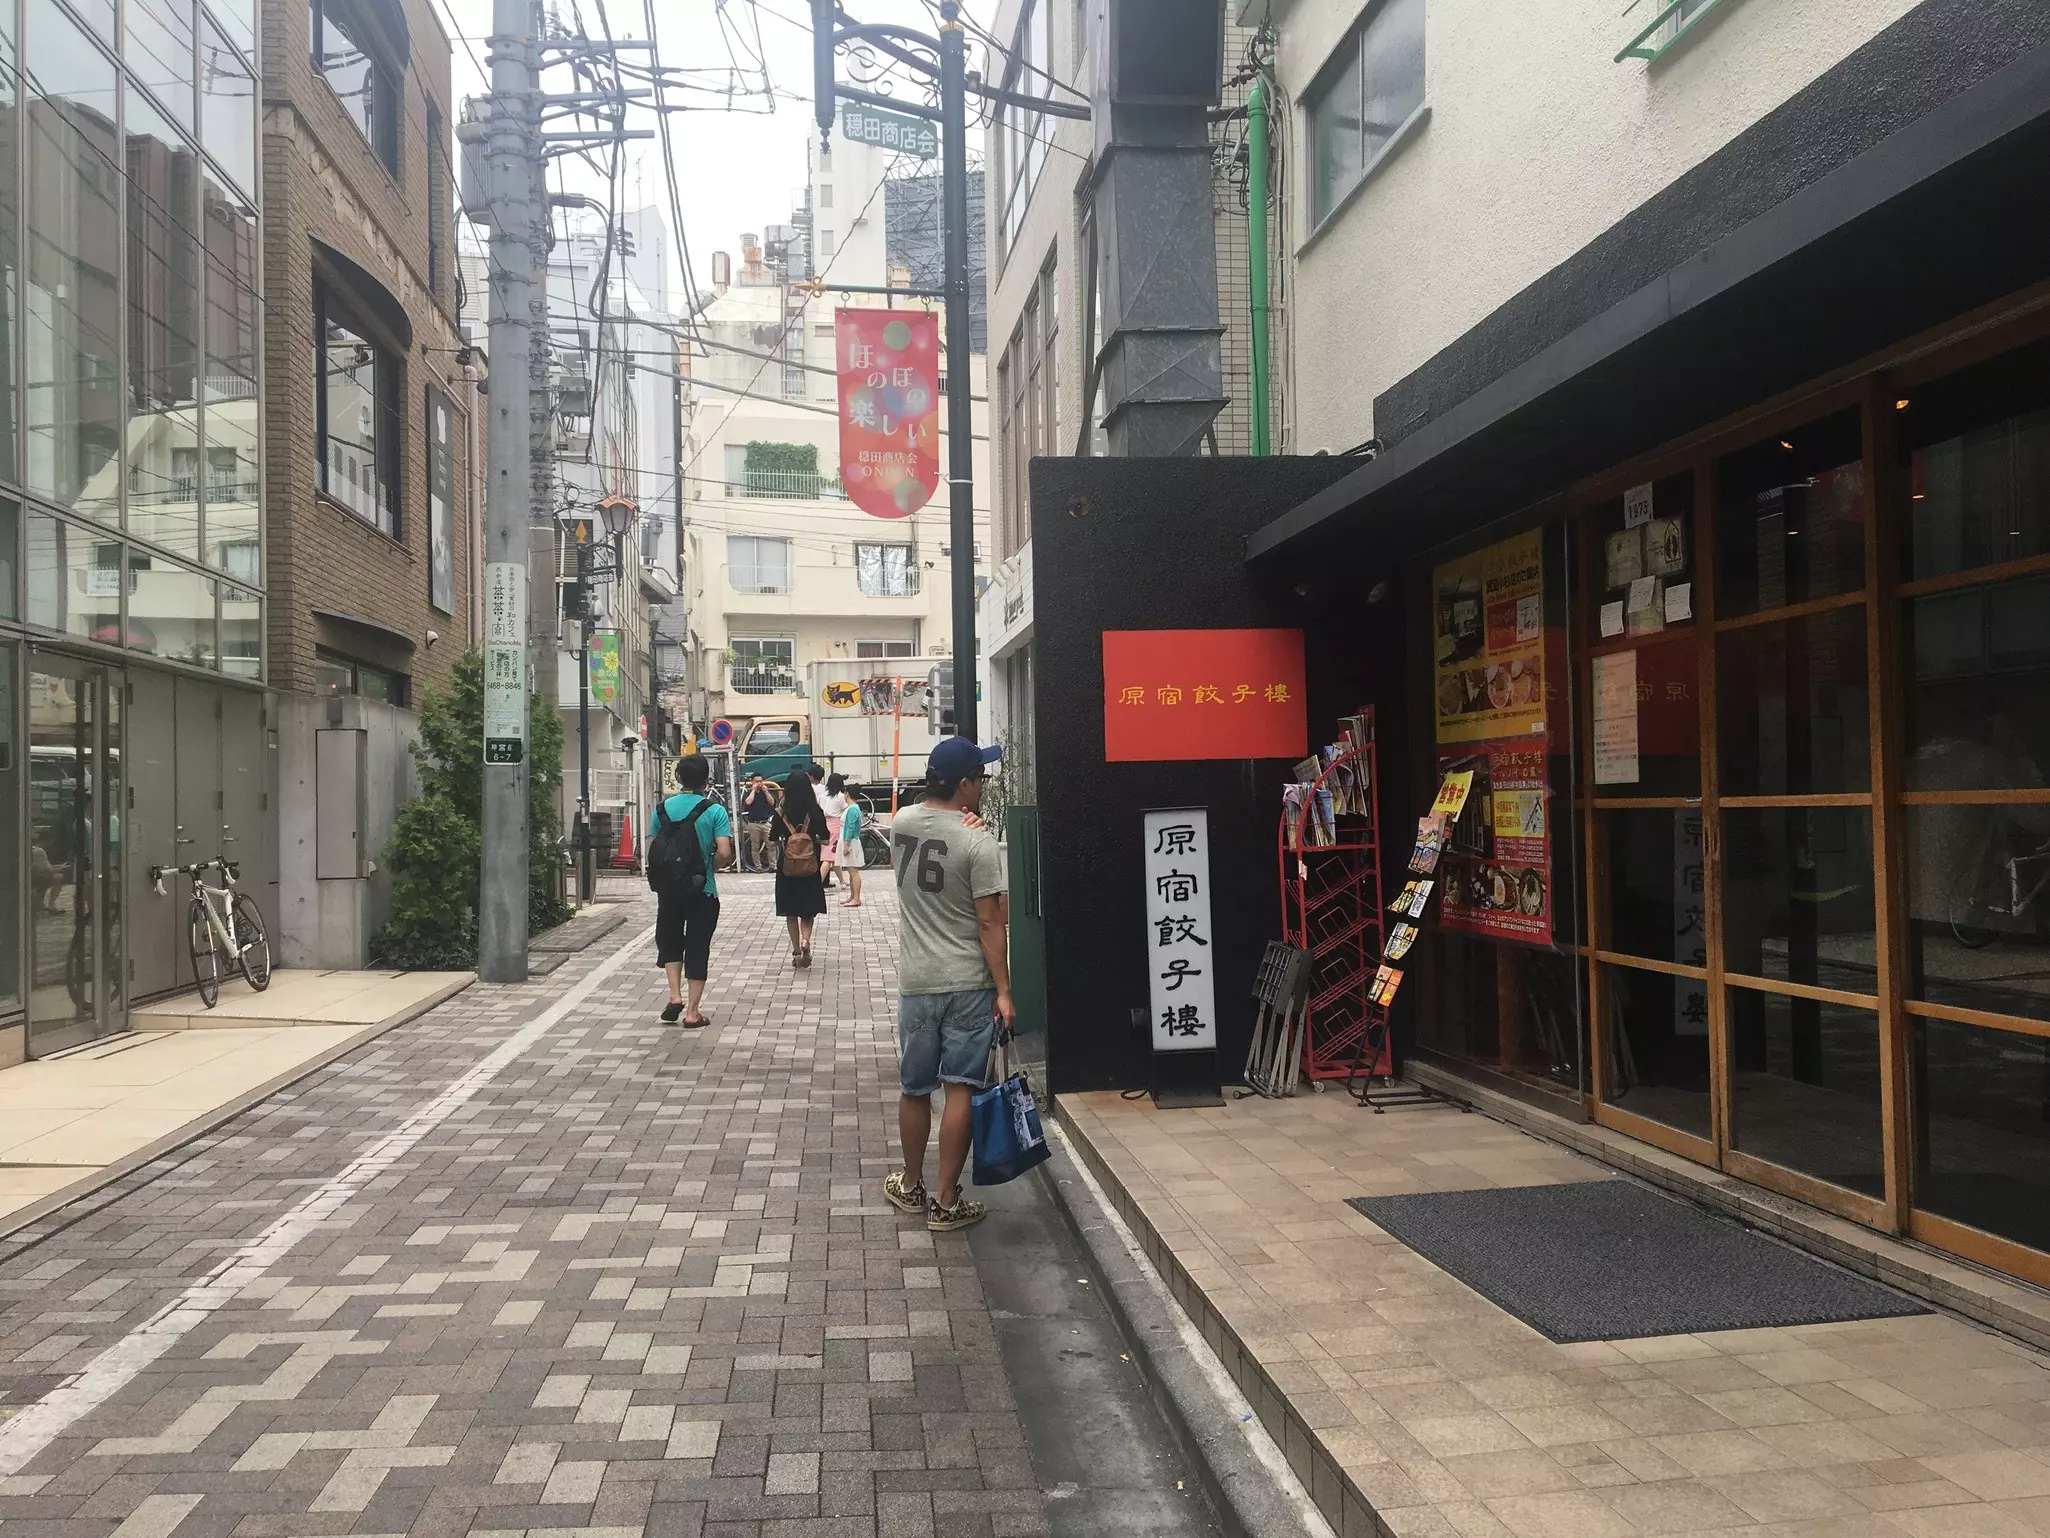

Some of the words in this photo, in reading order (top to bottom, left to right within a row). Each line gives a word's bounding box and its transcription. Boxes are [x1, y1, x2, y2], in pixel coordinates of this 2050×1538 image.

[845, 113, 934, 153] 穏田商店会
[849, 344, 926, 406] ほのぼの
[848, 400, 927, 441] 楽しい
[858, 450, 918, 464] 穏田商店会
[1628, 500, 1649, 520] 1975
[1118, 683, 1292, 706] 原宿餃子樓
[493, 753, 512, 761] 6-7
[893, 833, 949, 894] 76
[1154, 824, 1209, 1037] 原宿餃子樓
